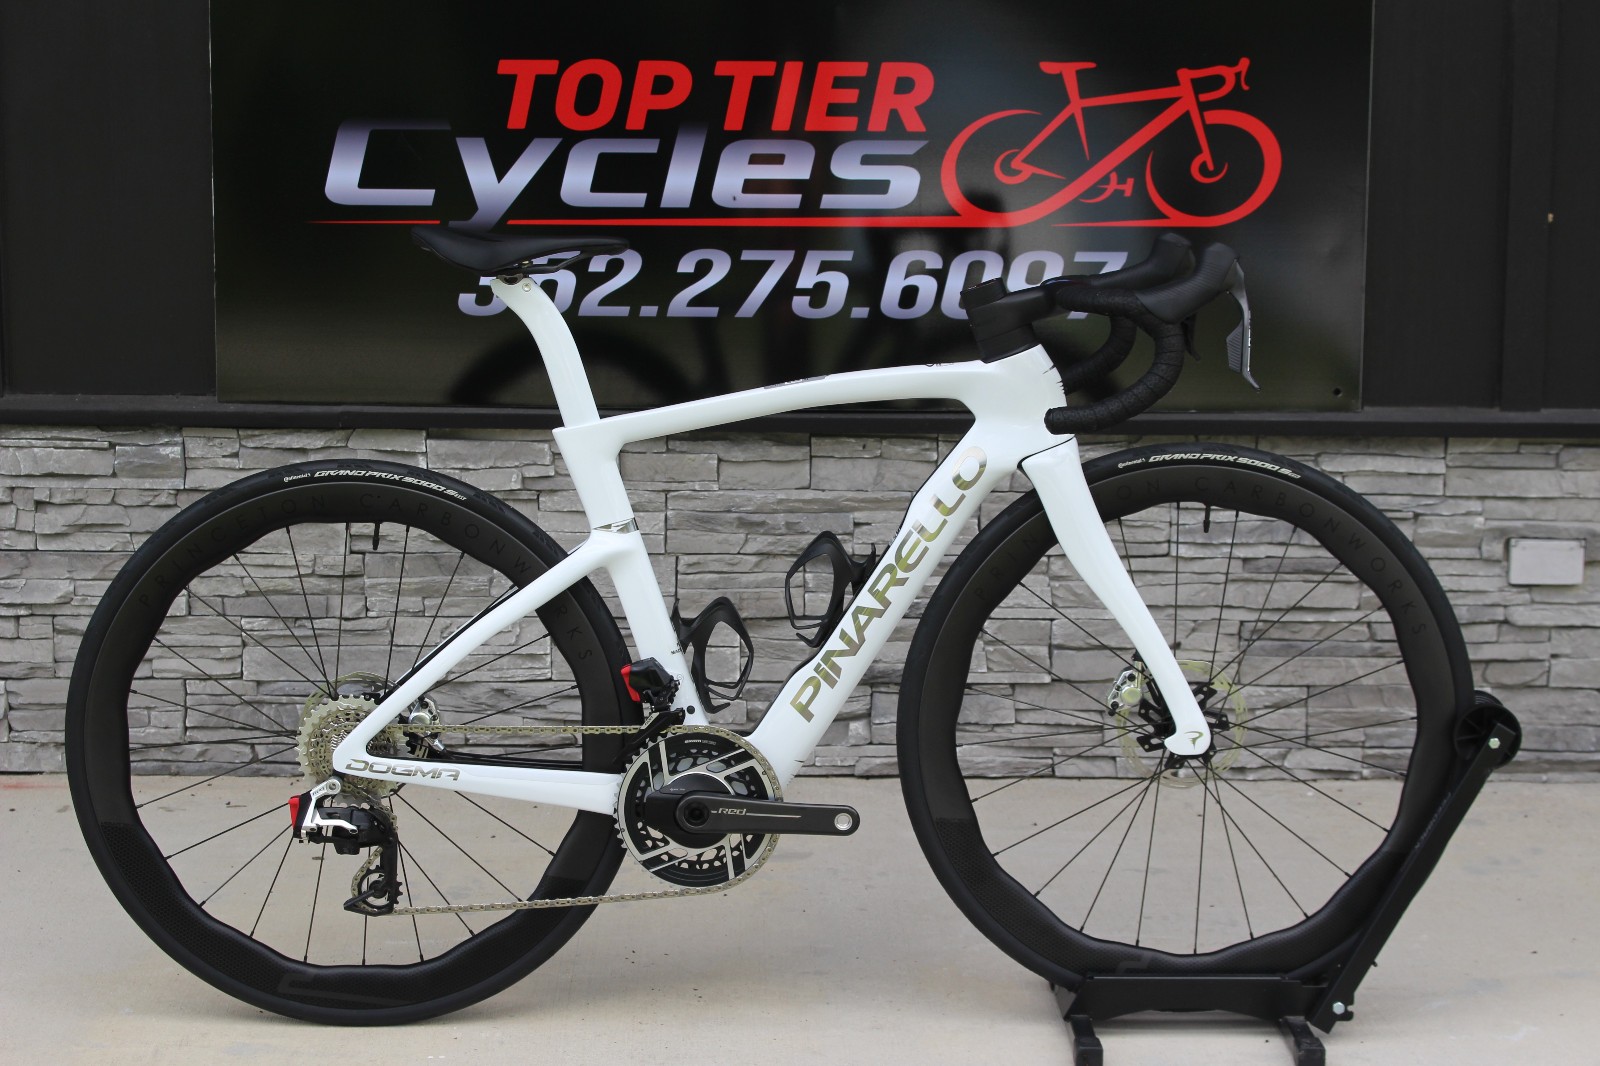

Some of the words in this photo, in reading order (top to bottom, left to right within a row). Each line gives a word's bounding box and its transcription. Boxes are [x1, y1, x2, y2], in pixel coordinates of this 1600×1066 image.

[497, 59, 692, 131] TOP
[714, 60, 935, 132] TIER
[324, 119, 929, 232] Cycles
[314, 469, 367, 478] GRAND
[365, 469, 404, 482] PRIX
[402, 476, 447, 492] 5000
[1148, 453, 1201, 463] GRAND
[1200, 453, 1239, 463] PRIX
[1236, 456, 1281, 472] 5000
[359, 493, 593, 660] CARBONWRKS
[1194, 476, 1427, 635] CARBONWORKS
[345, 758, 461, 782] DOGMA
